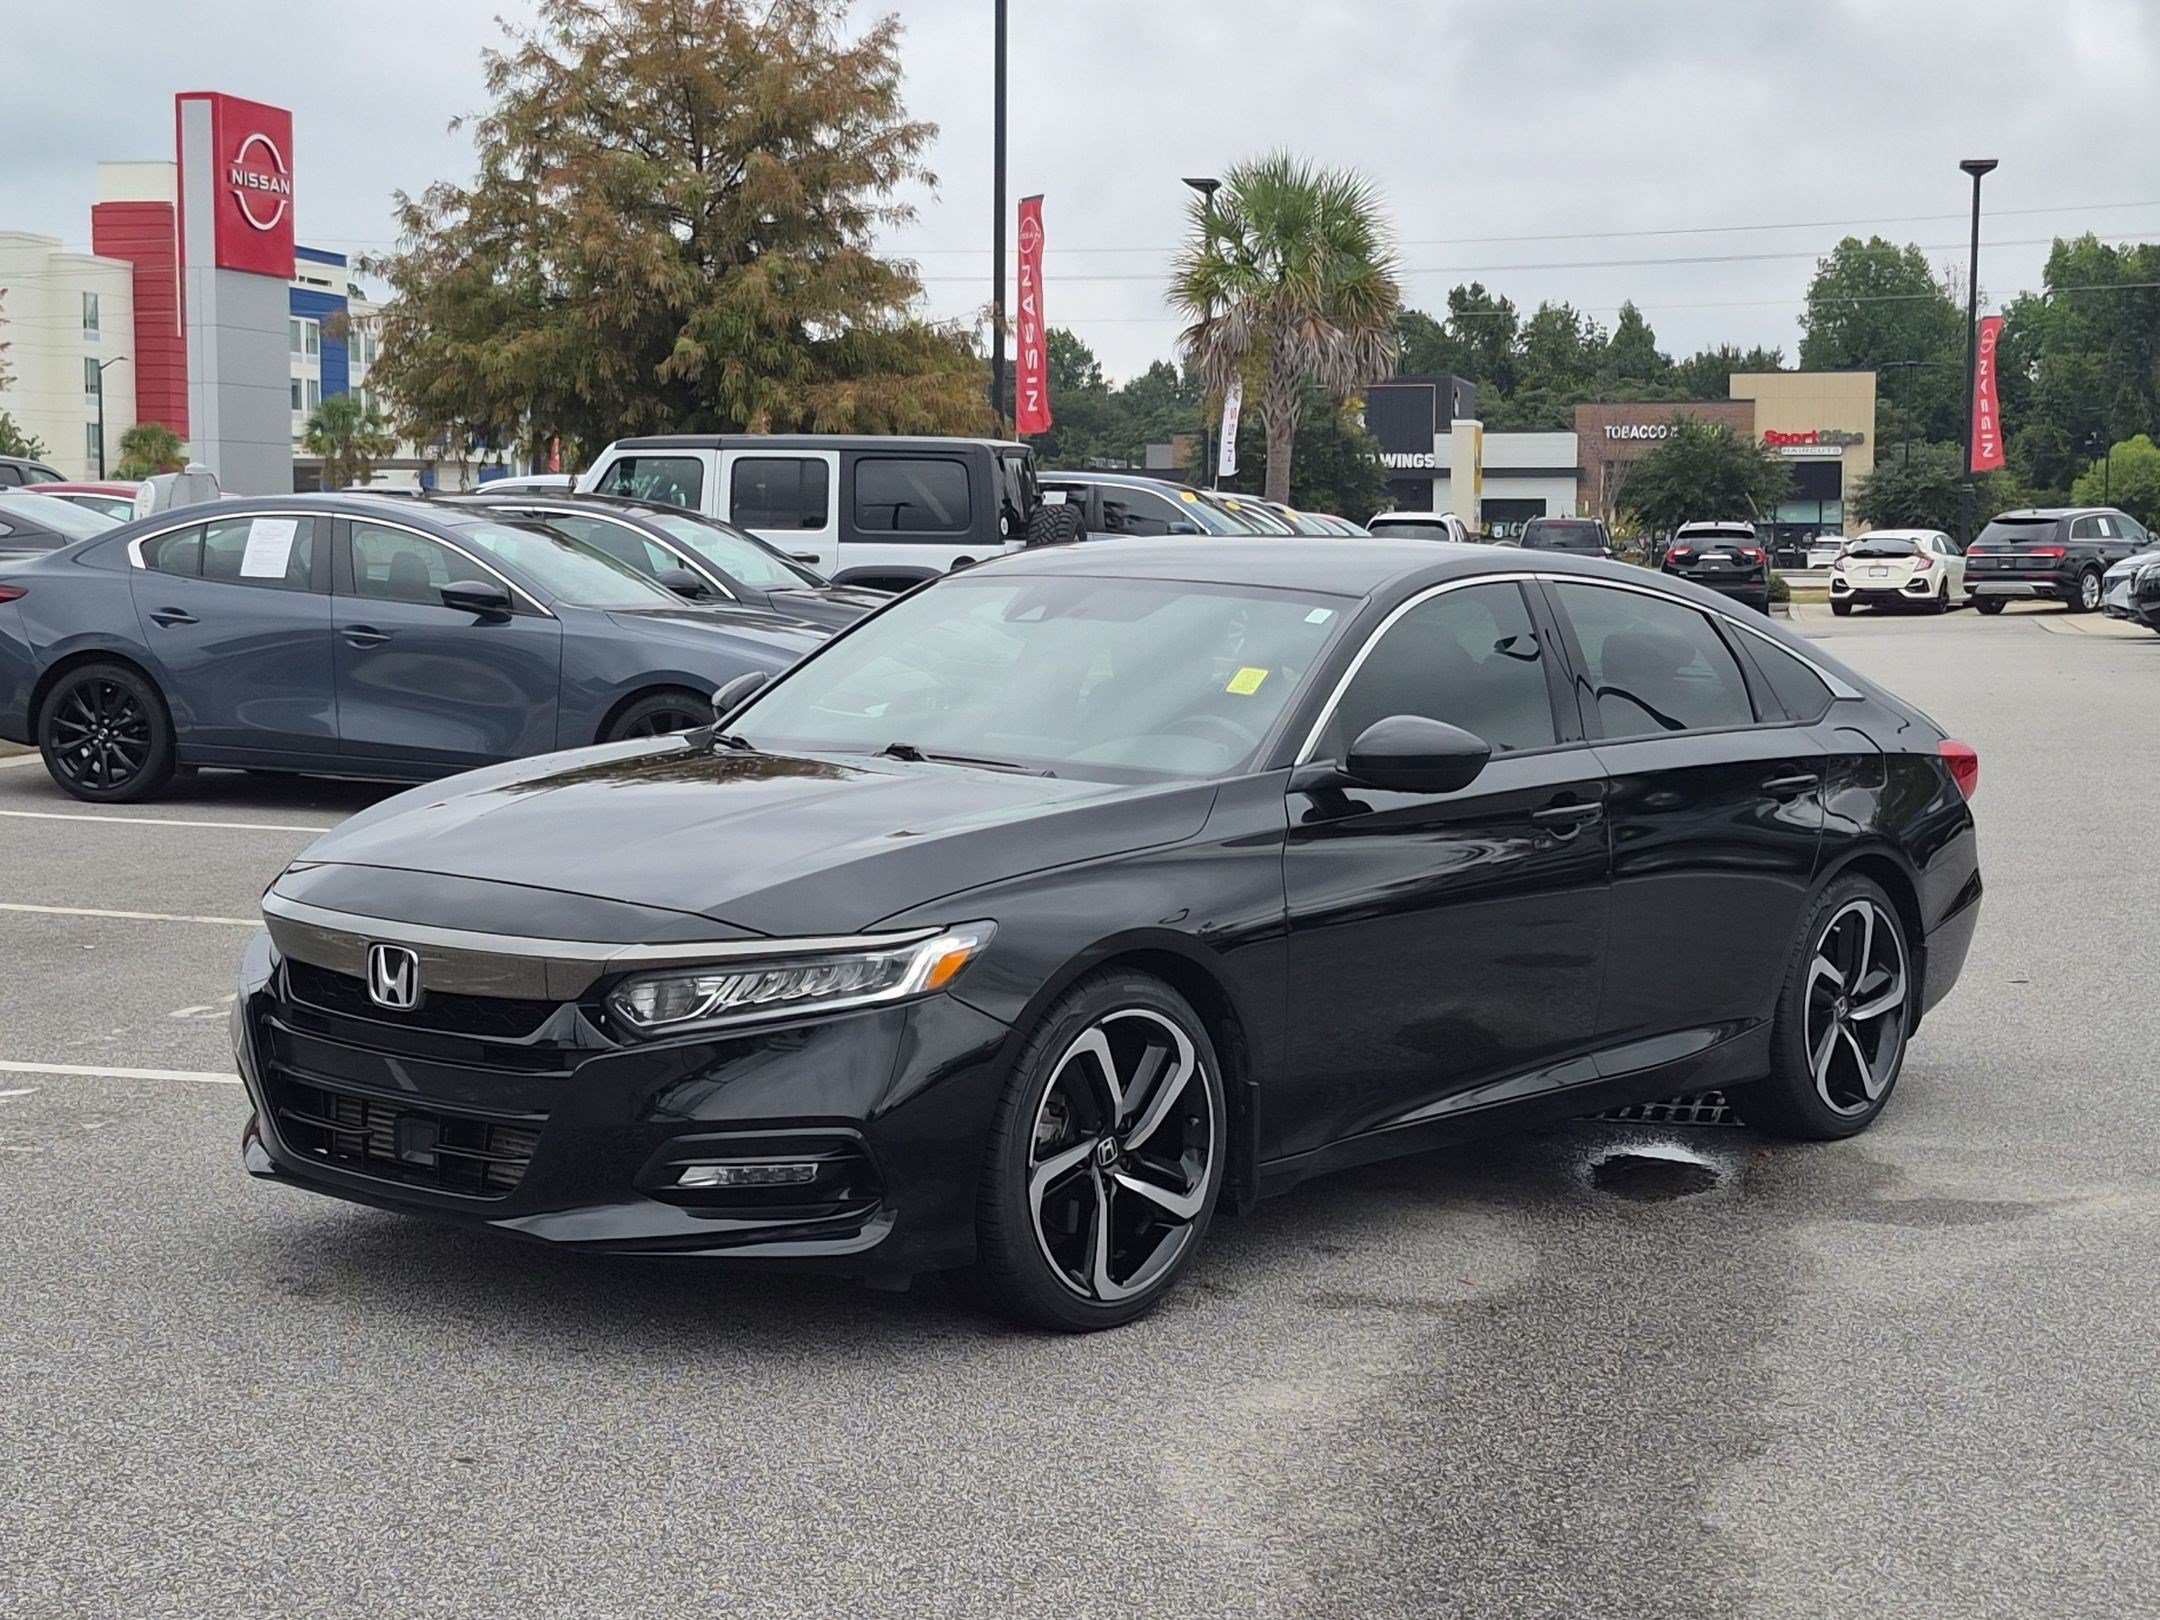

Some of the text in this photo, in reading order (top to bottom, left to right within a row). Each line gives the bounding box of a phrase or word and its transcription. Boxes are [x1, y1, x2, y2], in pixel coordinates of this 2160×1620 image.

[231, 168, 290, 195] NISSAN
[1021, 264, 1039, 412] NISSAN
[1980, 359, 1994, 458] NISSAN
[1603, 425, 1667, 439] TOBACCO
[1379, 453, 1435, 469] WINGS
